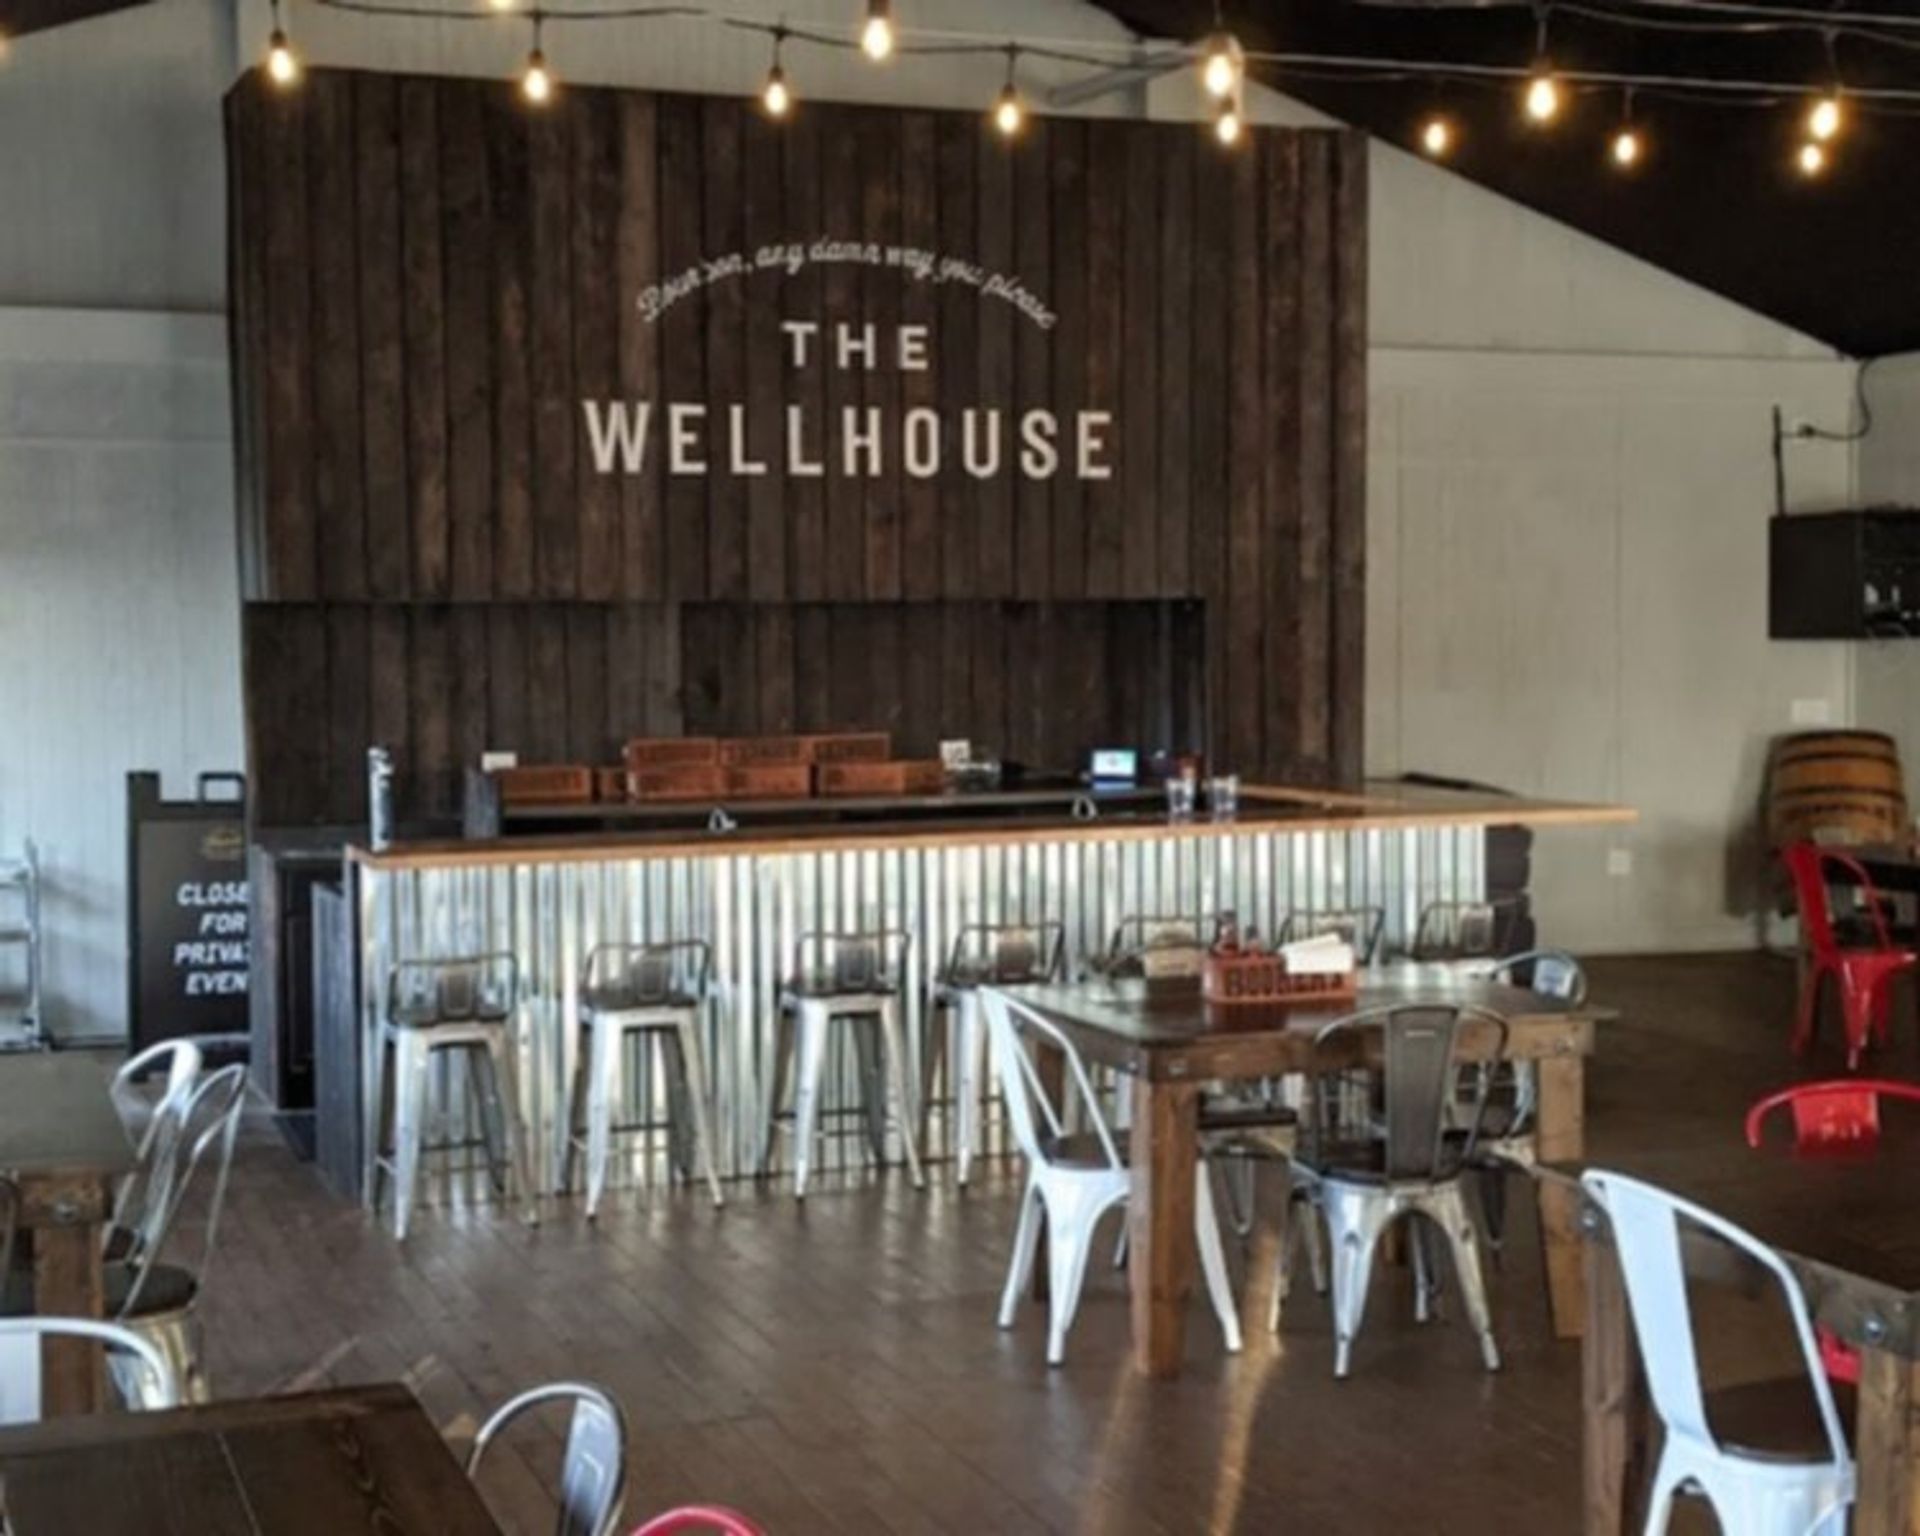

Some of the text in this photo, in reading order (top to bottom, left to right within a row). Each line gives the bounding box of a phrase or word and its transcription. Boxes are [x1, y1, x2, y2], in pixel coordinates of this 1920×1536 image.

[756, 243, 804, 275] any
[886, 247, 935, 280] way
[932, 257, 984, 284] you
[980, 274, 1057, 329] please
[782, 321, 928, 370] THE
[583, 399, 1112, 480] WELLHOUSE
[177, 882, 249, 906] CLOSE
[200, 912, 247, 934] FOR
[173, 942, 250, 965] PRIVA
[185, 972, 249, 995] EVEN
